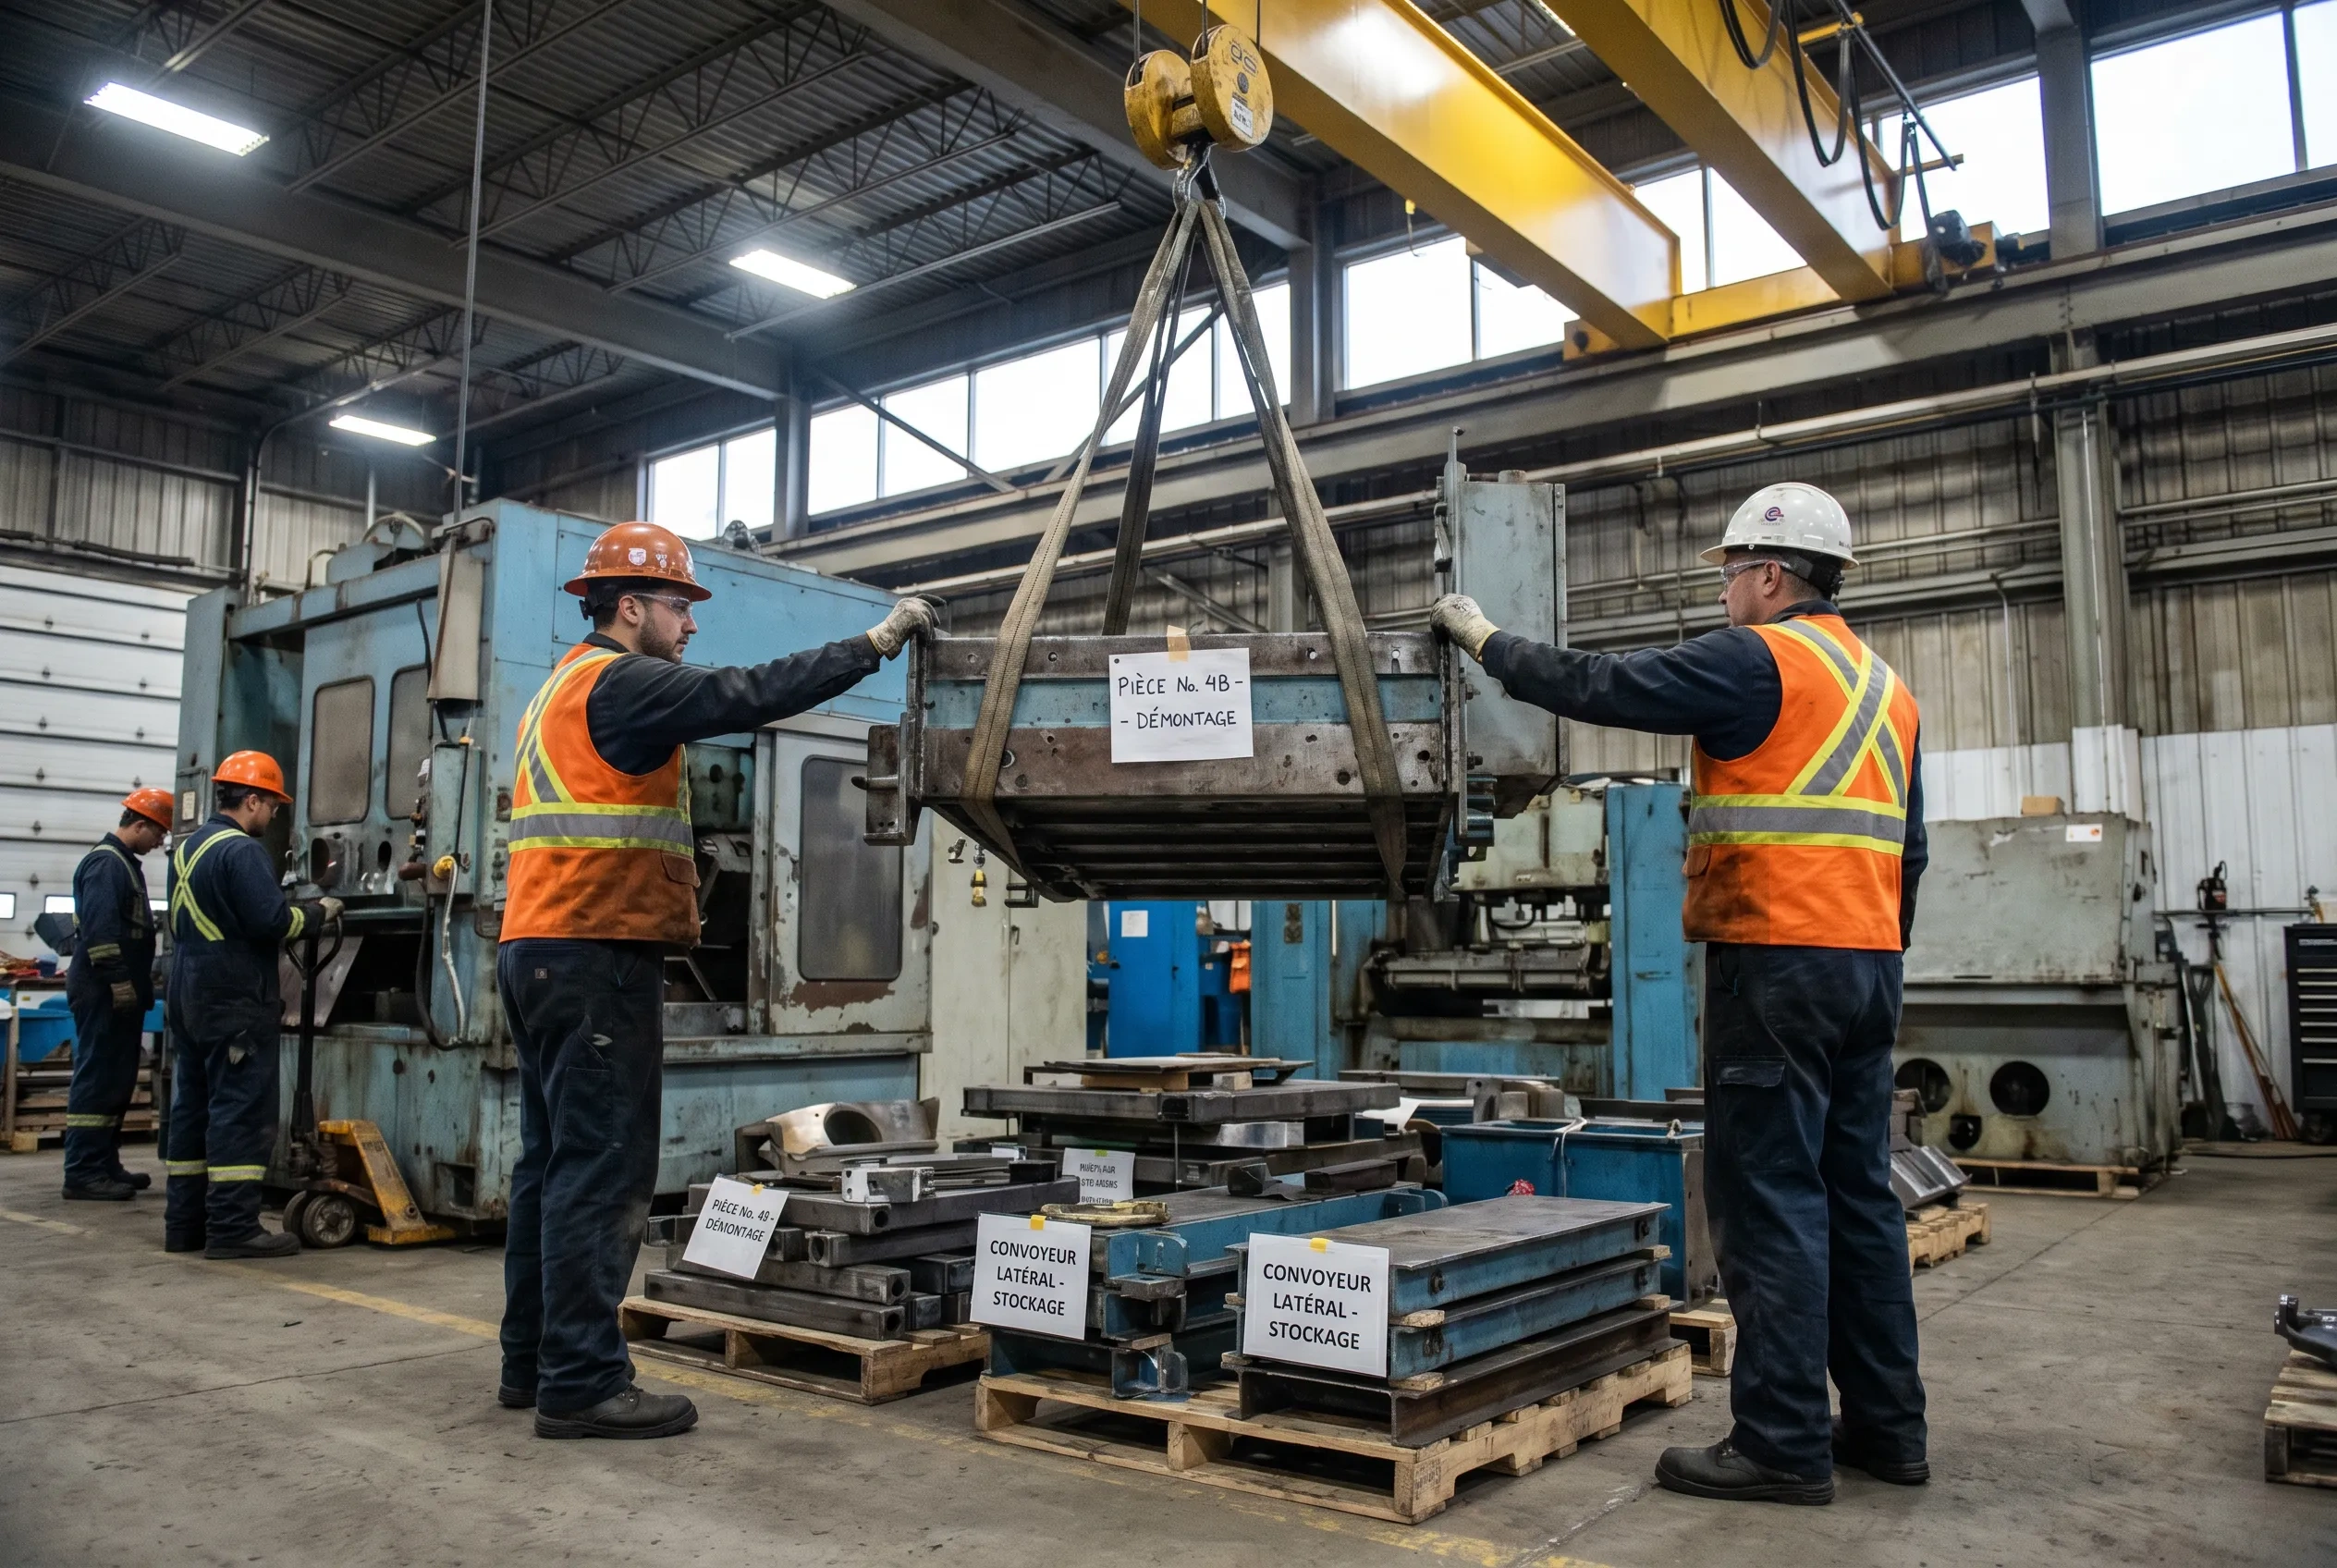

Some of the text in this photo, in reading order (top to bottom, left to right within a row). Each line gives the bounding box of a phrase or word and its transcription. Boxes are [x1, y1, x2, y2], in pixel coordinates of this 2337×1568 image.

[1119, 673, 1166, 696] PIÈCE
[1177, 676, 1199, 692] No.
[1137, 706, 1237, 729] DÉMONTAGE
[739, 1206, 754, 1219] No.
[705, 1217, 765, 1243] DÉMONTAGE
[990, 1240, 1076, 1265] CONVOYEUR
[997, 1266, 1056, 1288] LATÉRAL
[1263, 1263, 1371, 1292] CONVOYEUR
[993, 1291, 1065, 1316] STOCKAGE
[1273, 1292, 1347, 1318] LATÉRAL
[1268, 1321, 1360, 1350] STOCKAGE
